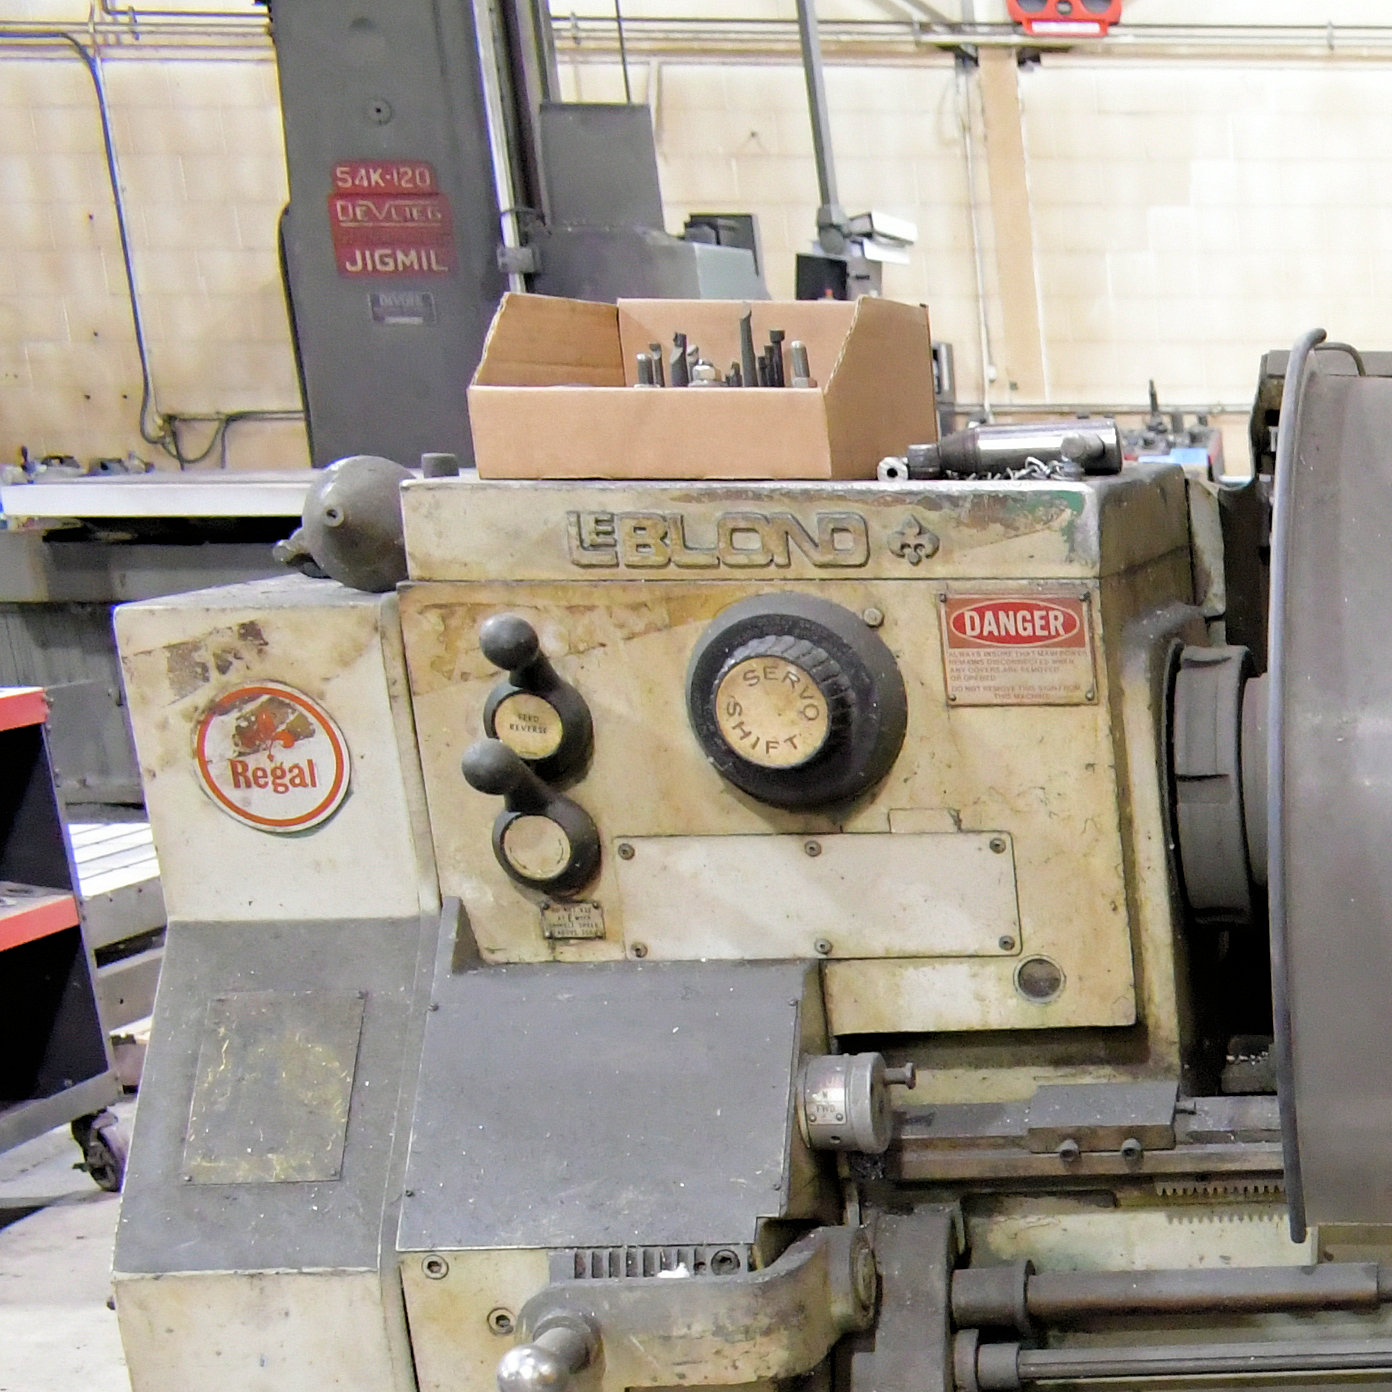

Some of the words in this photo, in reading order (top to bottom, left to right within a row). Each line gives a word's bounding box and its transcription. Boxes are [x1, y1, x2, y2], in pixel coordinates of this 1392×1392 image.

[345, 248, 449, 273] JIGMIL
[963, 609, 1066, 637] DANGER
[742, 665, 820, 722] SERVO
[509, 723, 548, 734] REVERSE
[726, 694, 798, 755] SHIFT
[229, 758, 317, 795] Regal
